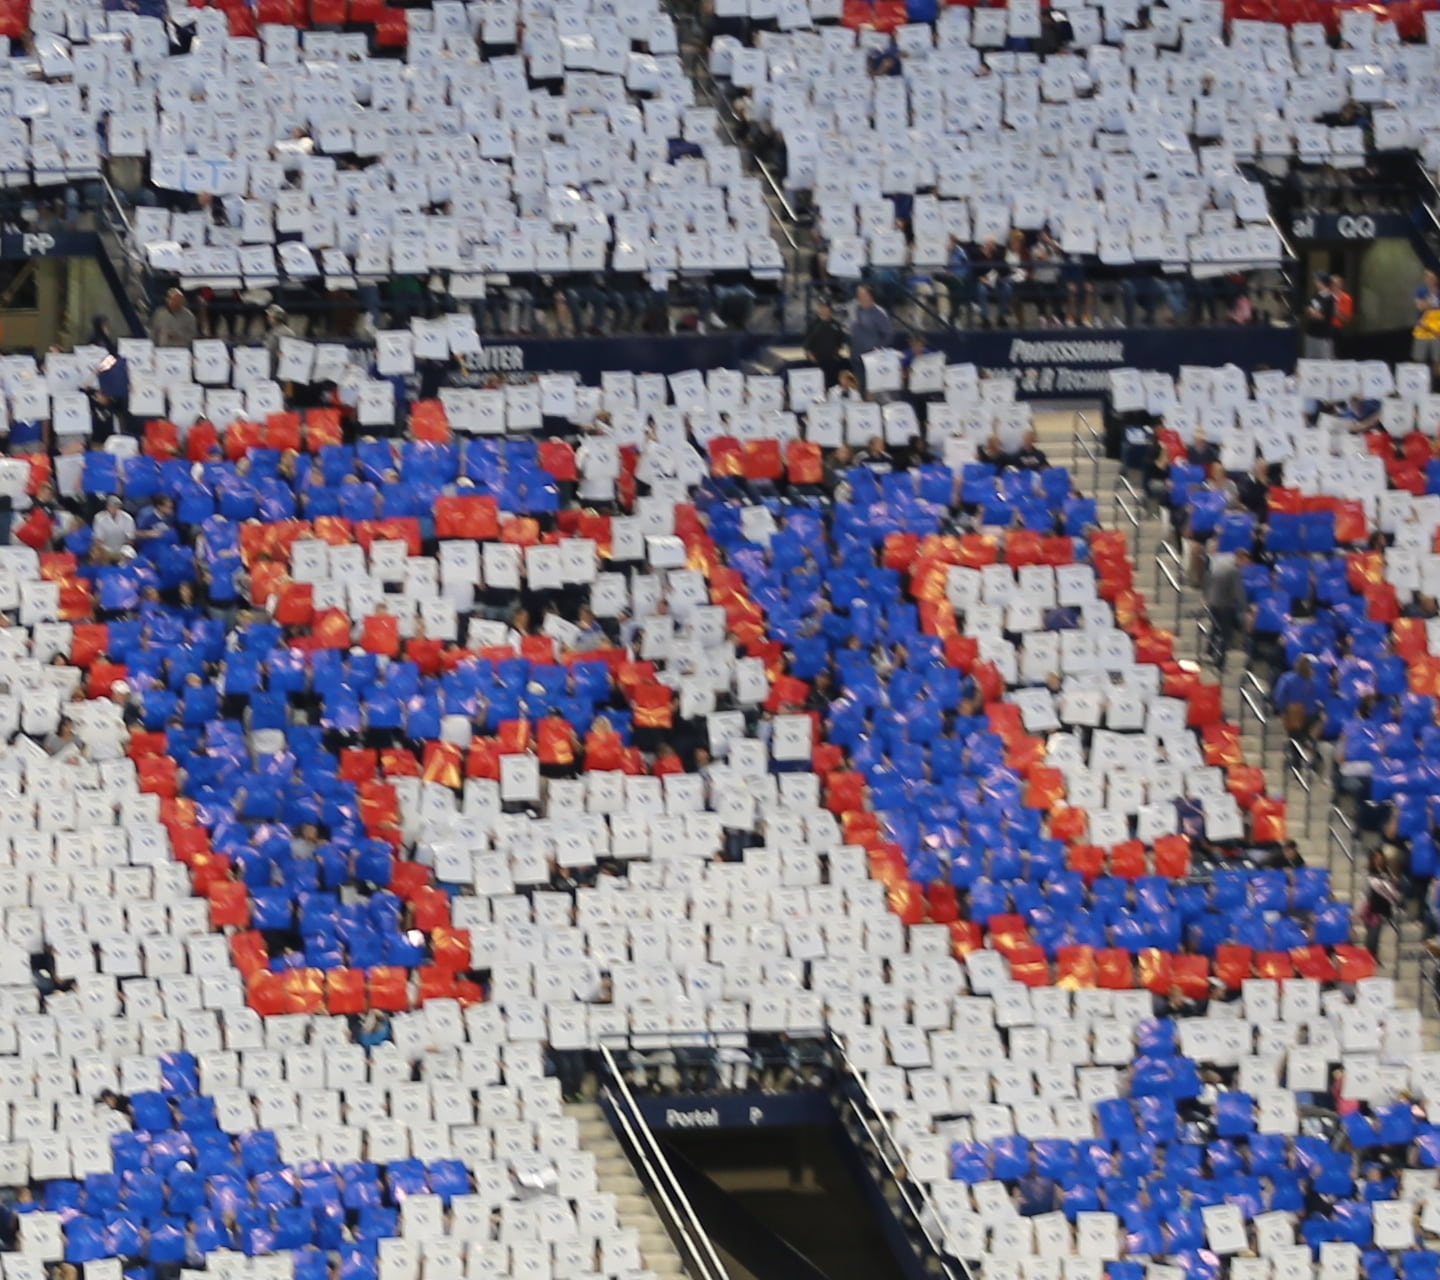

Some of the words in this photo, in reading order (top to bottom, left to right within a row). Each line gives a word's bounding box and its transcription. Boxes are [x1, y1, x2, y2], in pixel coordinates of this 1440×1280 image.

[1337, 215, 1376, 239] QQ
[23, 233, 56, 256] PP
[466, 346, 524, 372] ENTER
[666, 1107, 720, 1128] Portal
[749, 1106, 763, 1125] P
